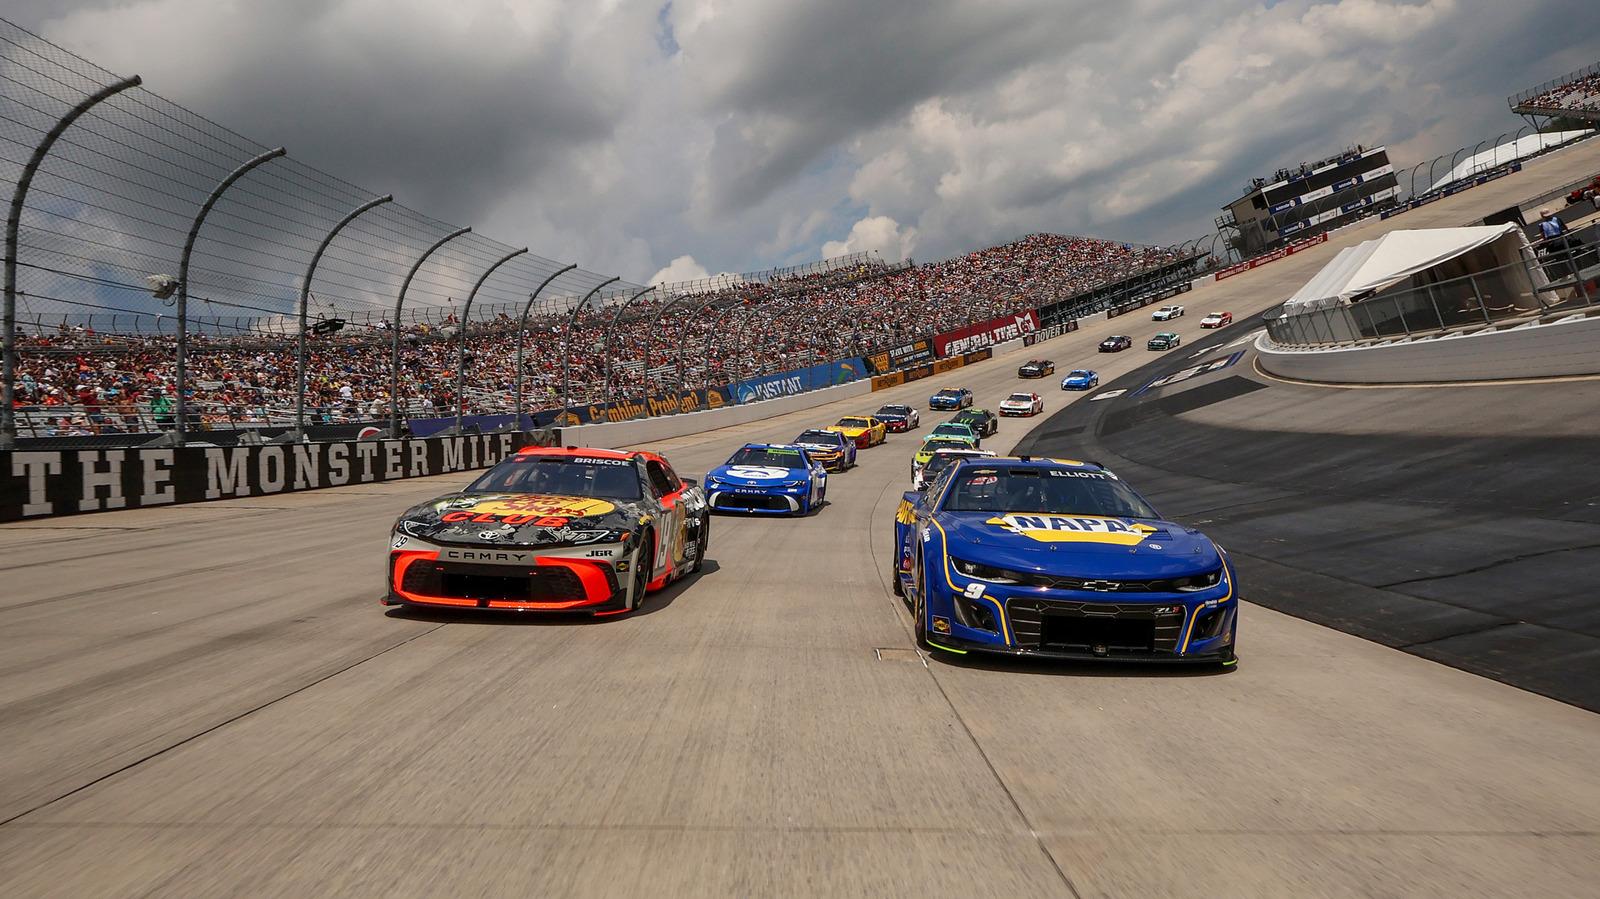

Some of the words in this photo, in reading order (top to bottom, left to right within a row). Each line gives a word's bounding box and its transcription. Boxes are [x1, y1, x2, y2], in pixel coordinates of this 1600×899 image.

[944, 331, 996, 356] GENERAL
[993, 323, 1019, 342] TIRE
[1035, 326, 1061, 344] DOVER
[755, 376, 803, 400] INSTANT
[574, 457, 630, 466] BRISCOE
[12, 449, 175, 516] THE
[205, 440, 428, 499] MONSTER
[442, 433, 512, 472] MILE
[1050, 470, 1105, 480] ELLIOTT
[442, 511, 569, 527] CLUB
[1013, 516, 1129, 533] NAPA
[448, 551, 527, 561] CAMRY
[963, 583, 986, 599] 9
